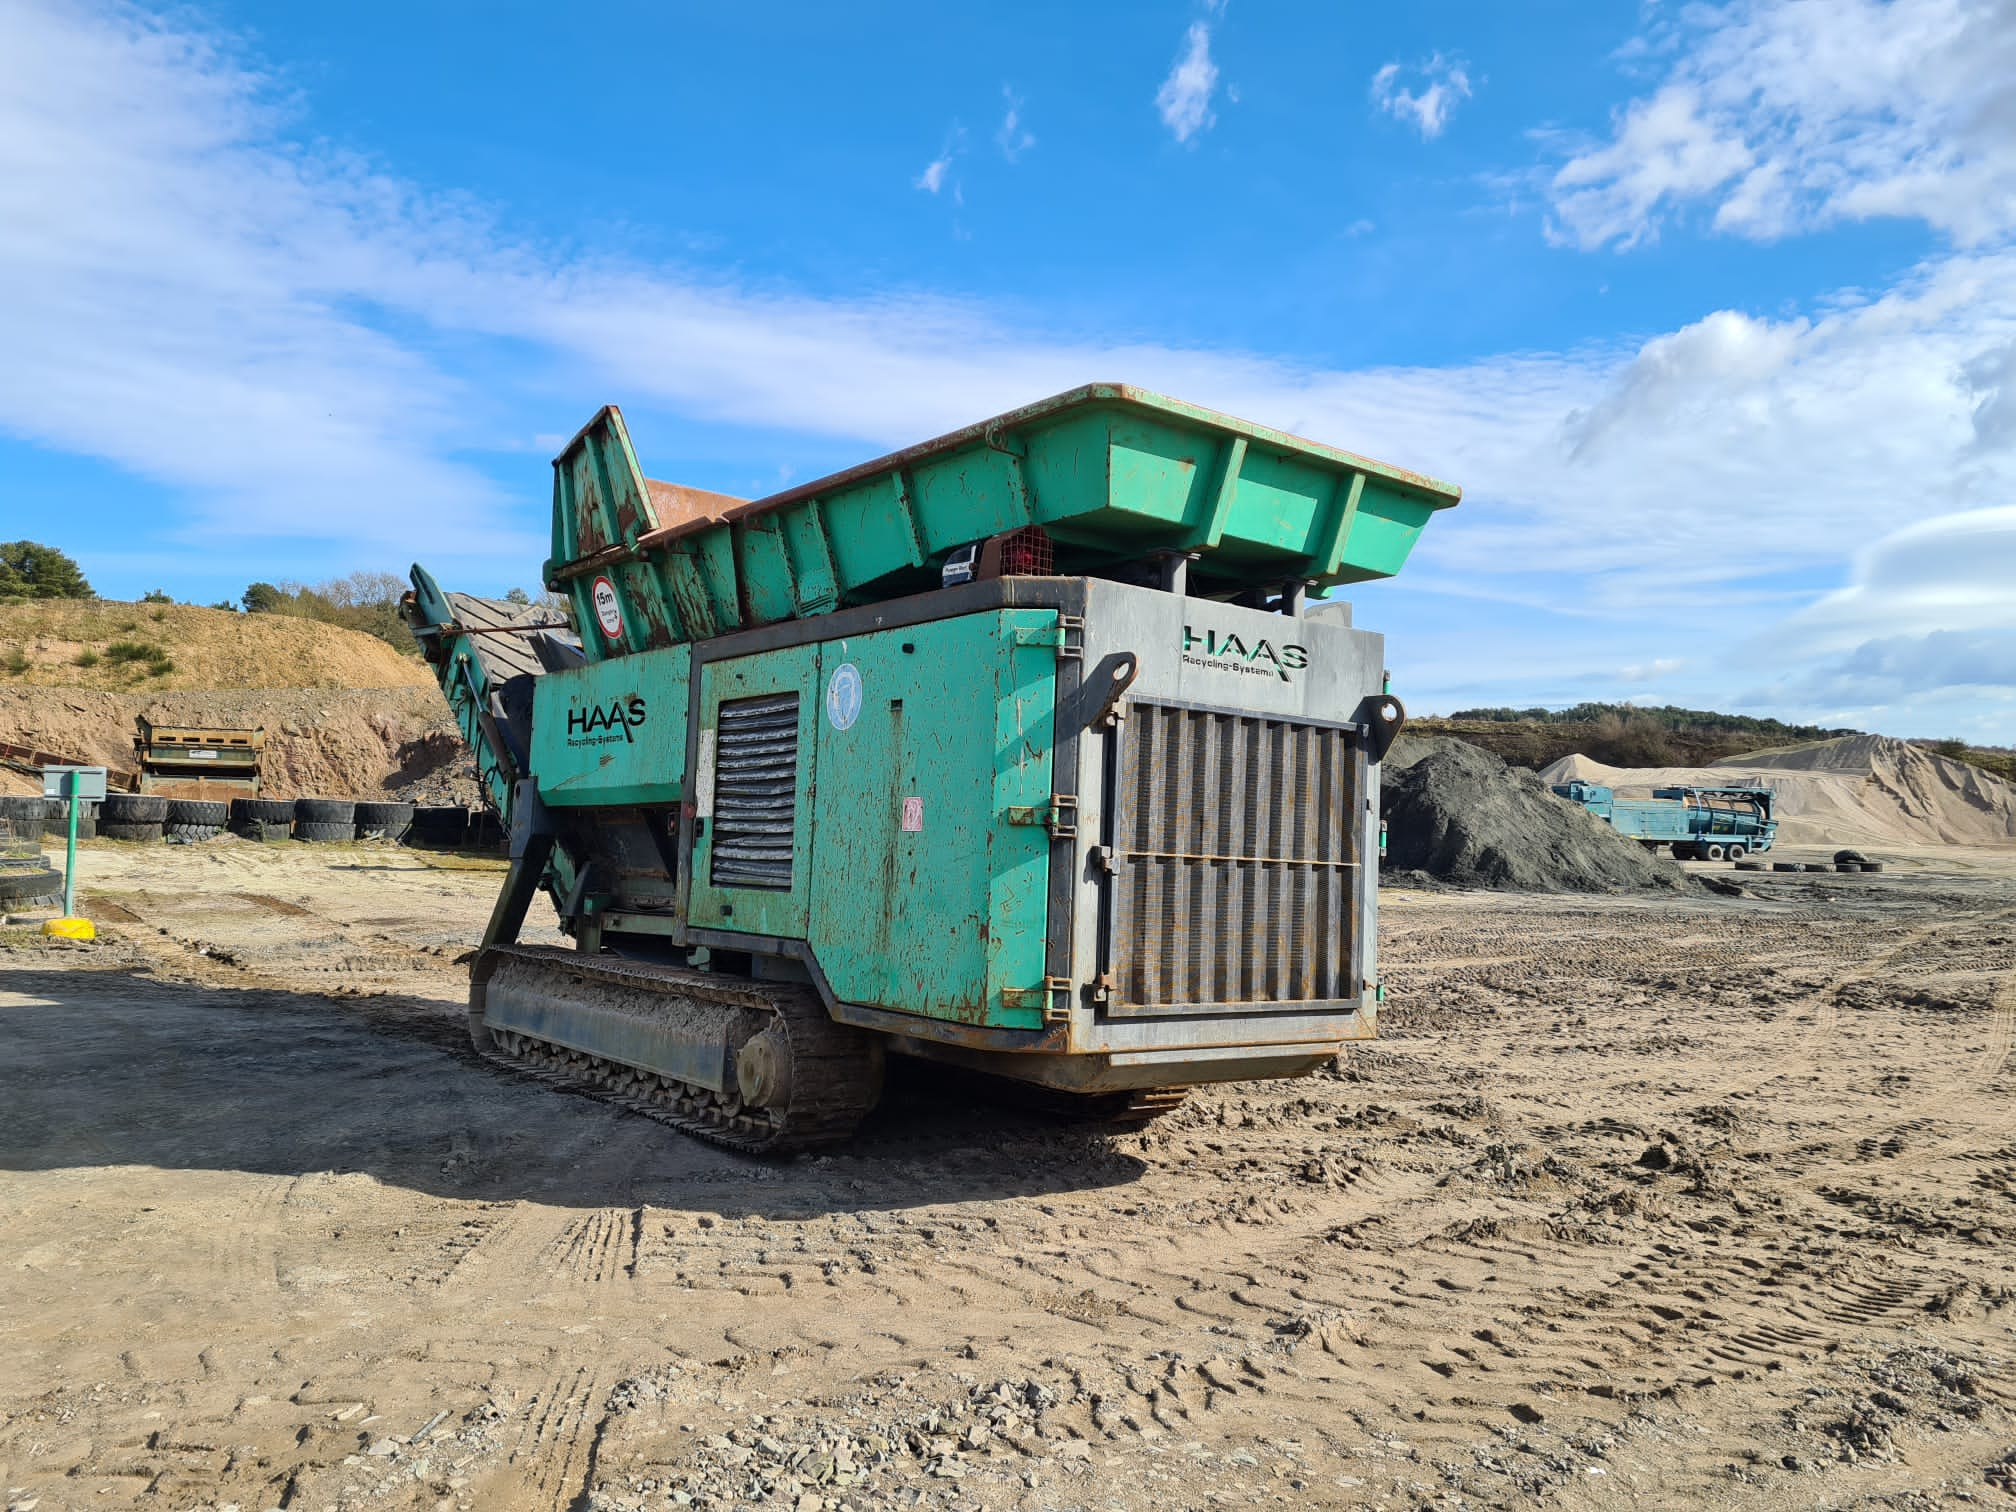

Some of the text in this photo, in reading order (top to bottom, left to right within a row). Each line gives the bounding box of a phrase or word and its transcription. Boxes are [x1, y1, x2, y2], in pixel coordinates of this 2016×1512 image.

[596, 592, 614, 606] 15m
[1183, 625, 1308, 682] HAAS
[567, 698, 646, 743] HAAS
